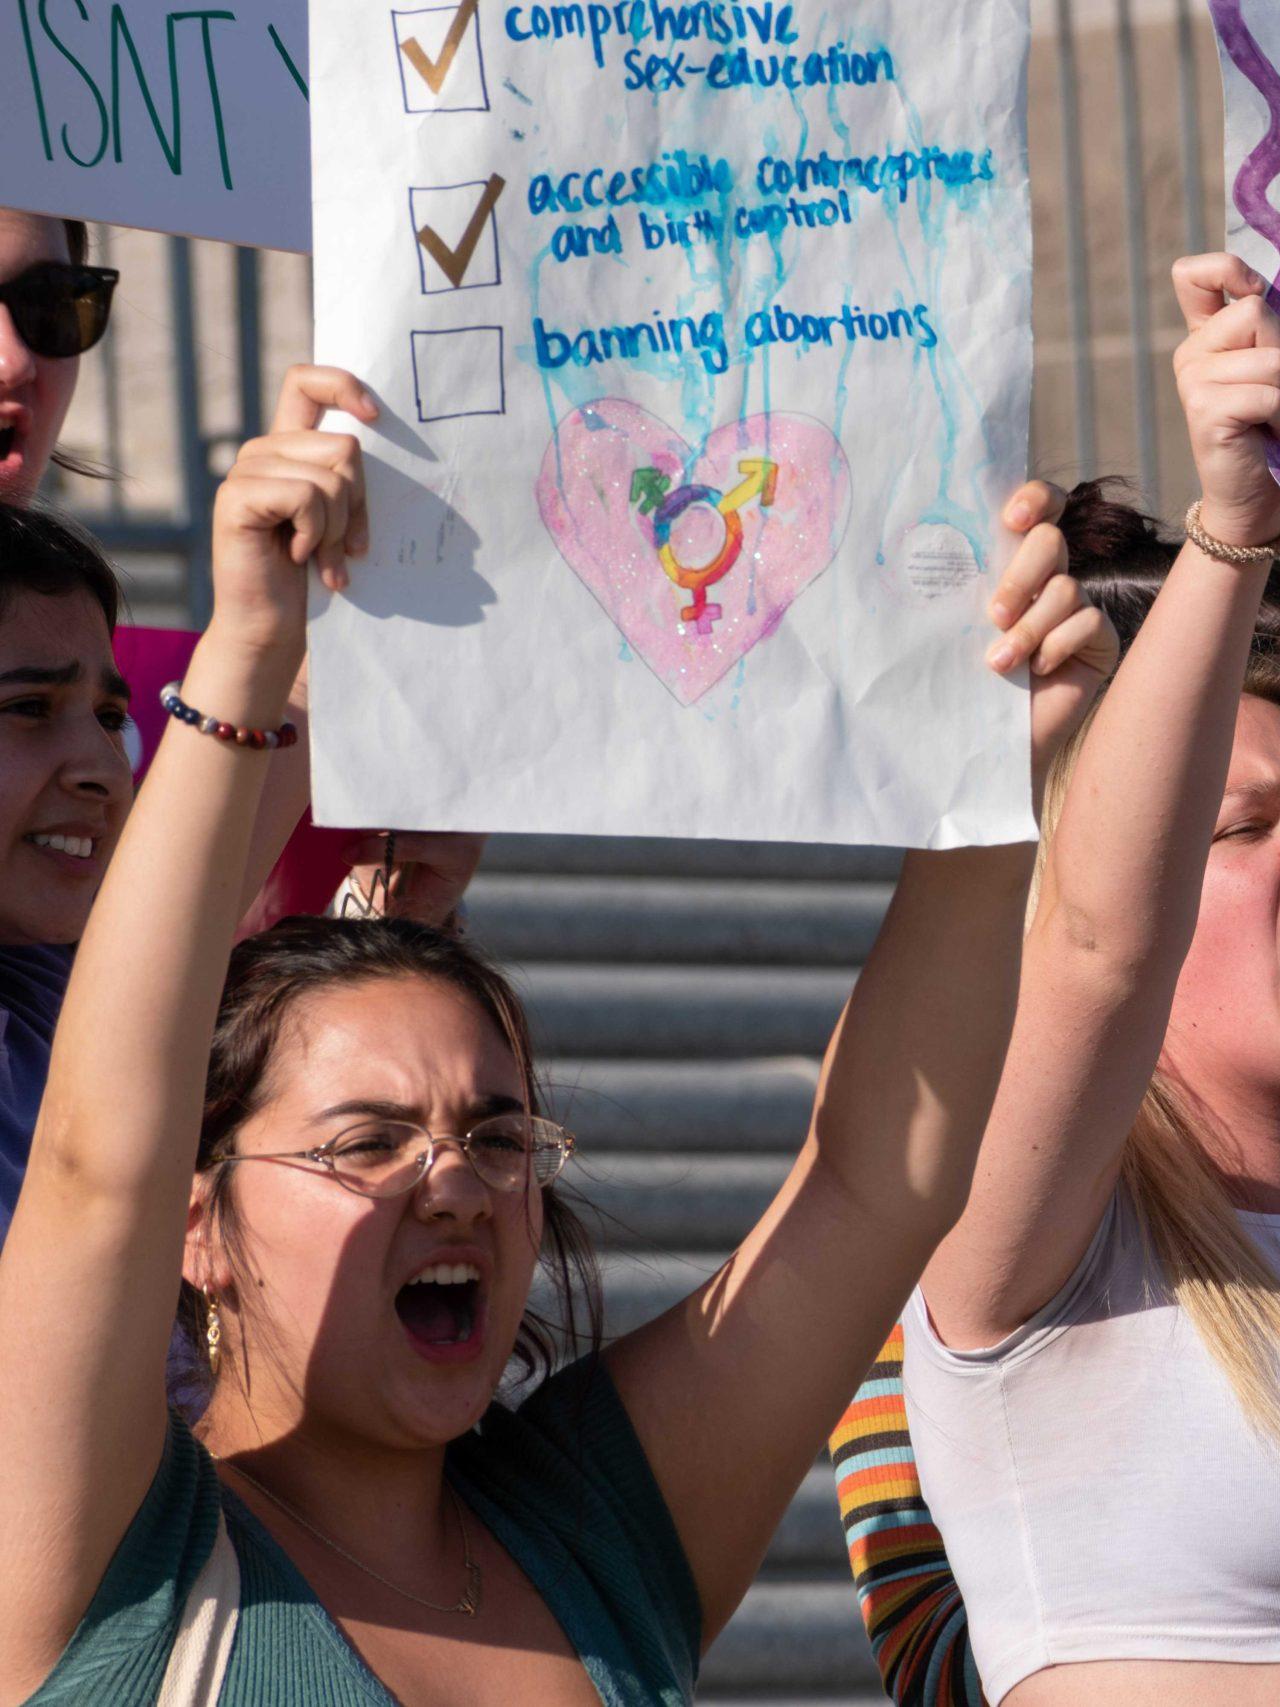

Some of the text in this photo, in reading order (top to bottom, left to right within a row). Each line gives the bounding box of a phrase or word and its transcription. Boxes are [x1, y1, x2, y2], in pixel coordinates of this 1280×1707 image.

[505, 0, 800, 68] comprehensive
[623, 41, 895, 91] sex-education
[528, 150, 732, 216] accessible
[552, 189, 852, 262] and birth control
[534, 303, 938, 374] banning abortions
